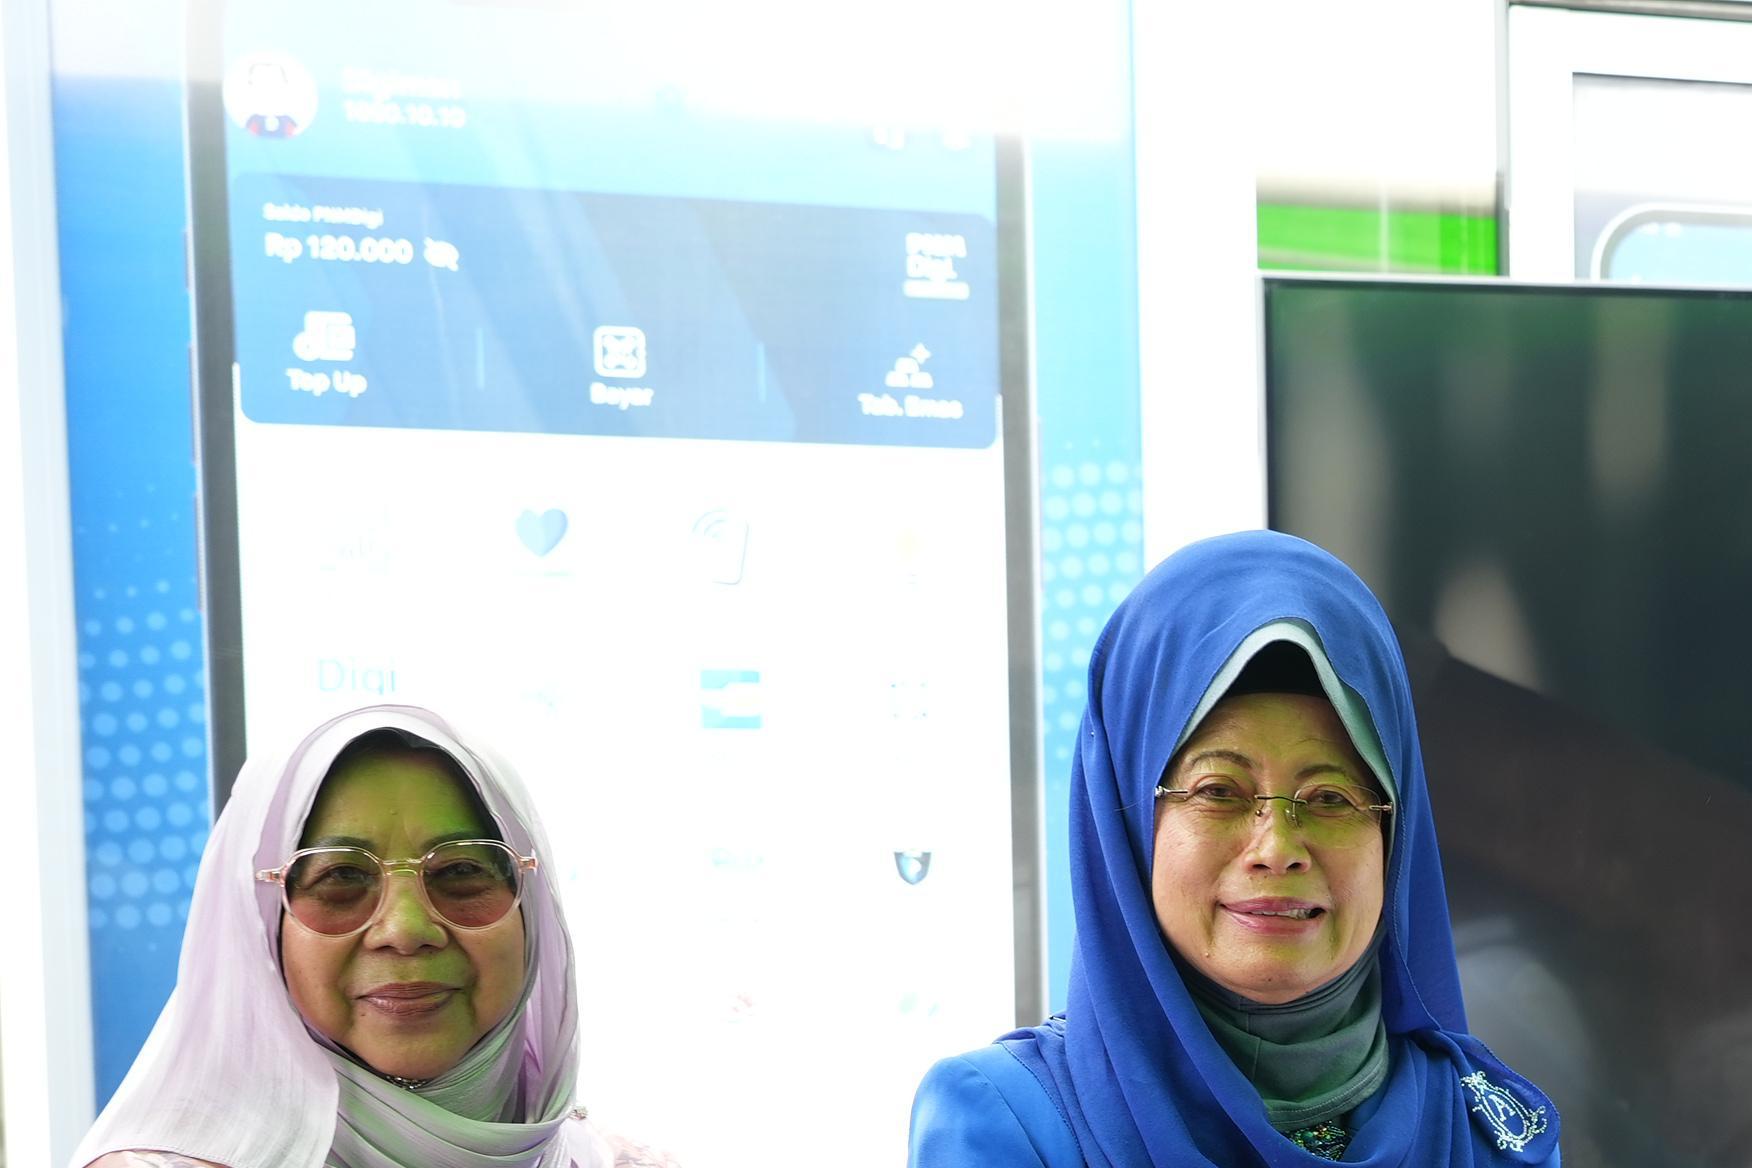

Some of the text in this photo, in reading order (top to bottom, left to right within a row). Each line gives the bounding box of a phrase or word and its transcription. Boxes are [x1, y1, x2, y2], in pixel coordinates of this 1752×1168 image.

[264, 232, 414, 264] Rp 120.000
[286, 368, 368, 398] Top Up
